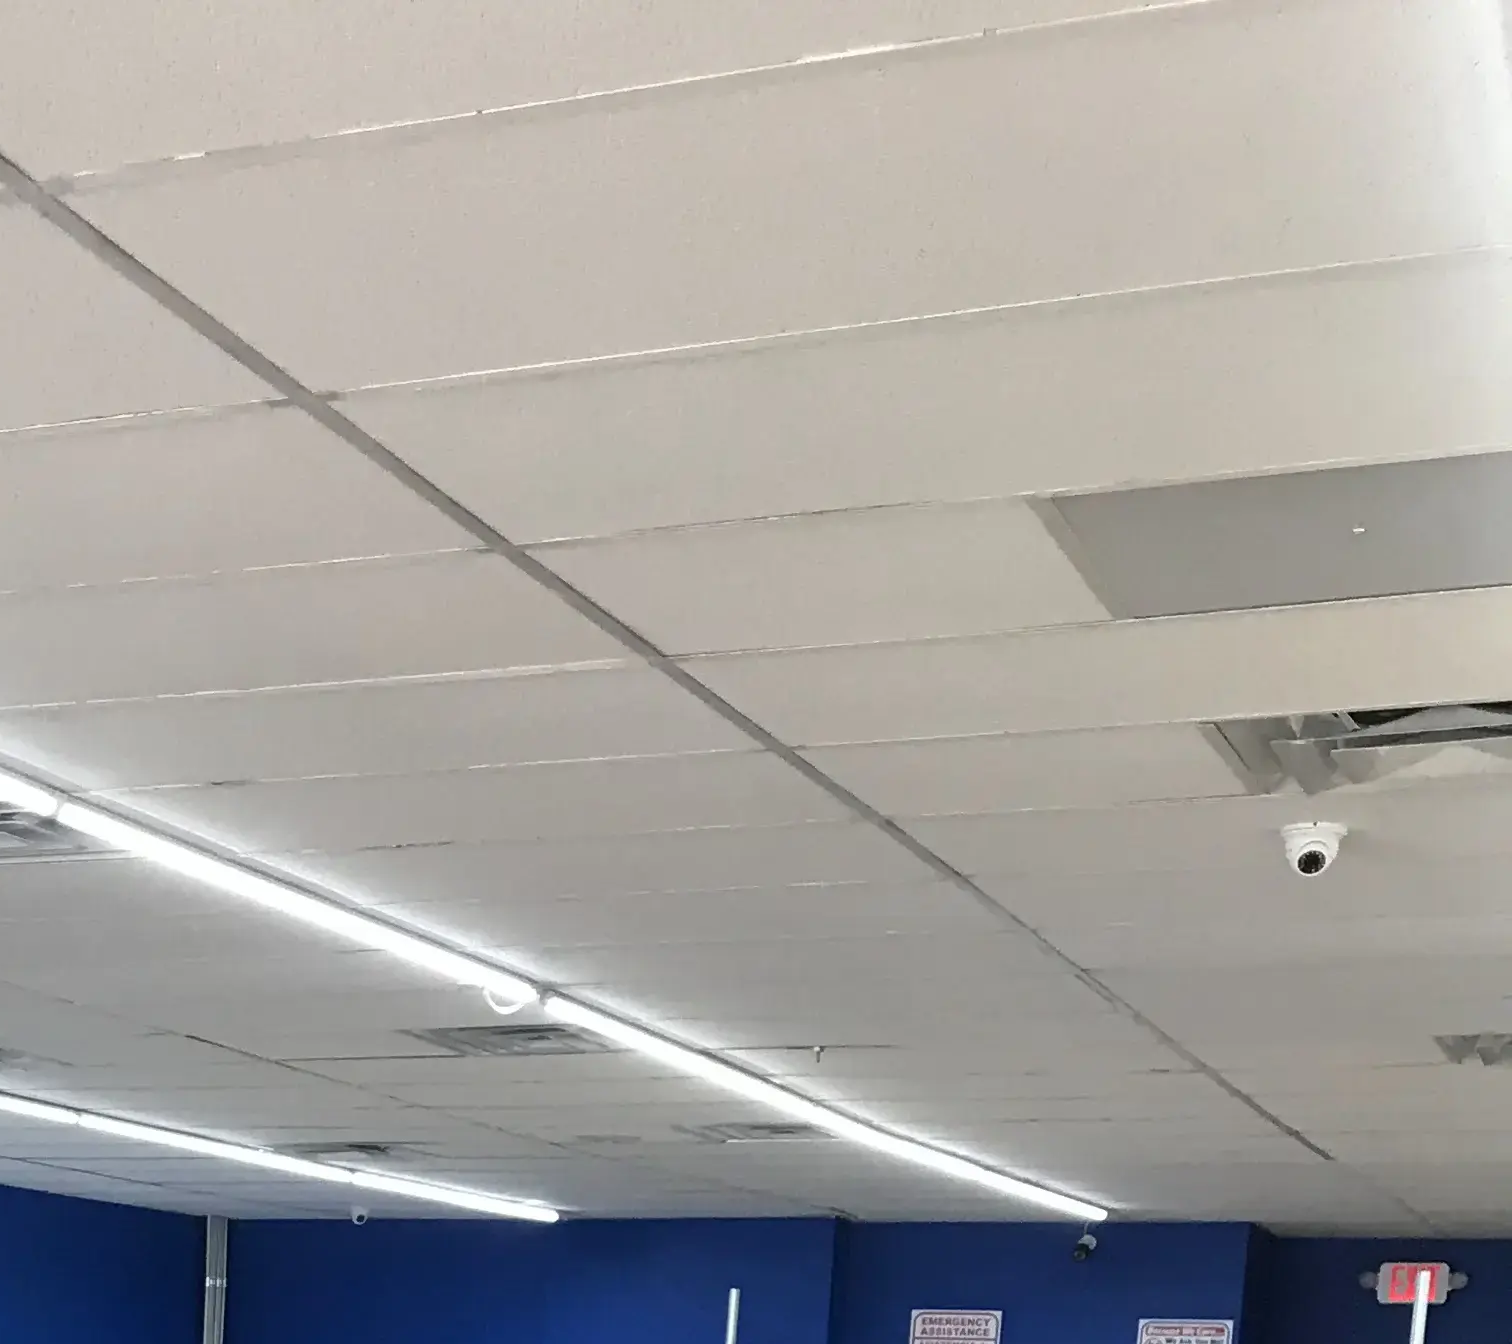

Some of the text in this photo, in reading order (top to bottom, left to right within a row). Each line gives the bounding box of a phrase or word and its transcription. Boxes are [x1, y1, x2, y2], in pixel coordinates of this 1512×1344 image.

[1389, 1265, 1441, 1302] EXT
[921, 1317, 991, 1327] EMERGENCY
[919, 1327, 990, 1337] ASSISTANCE
